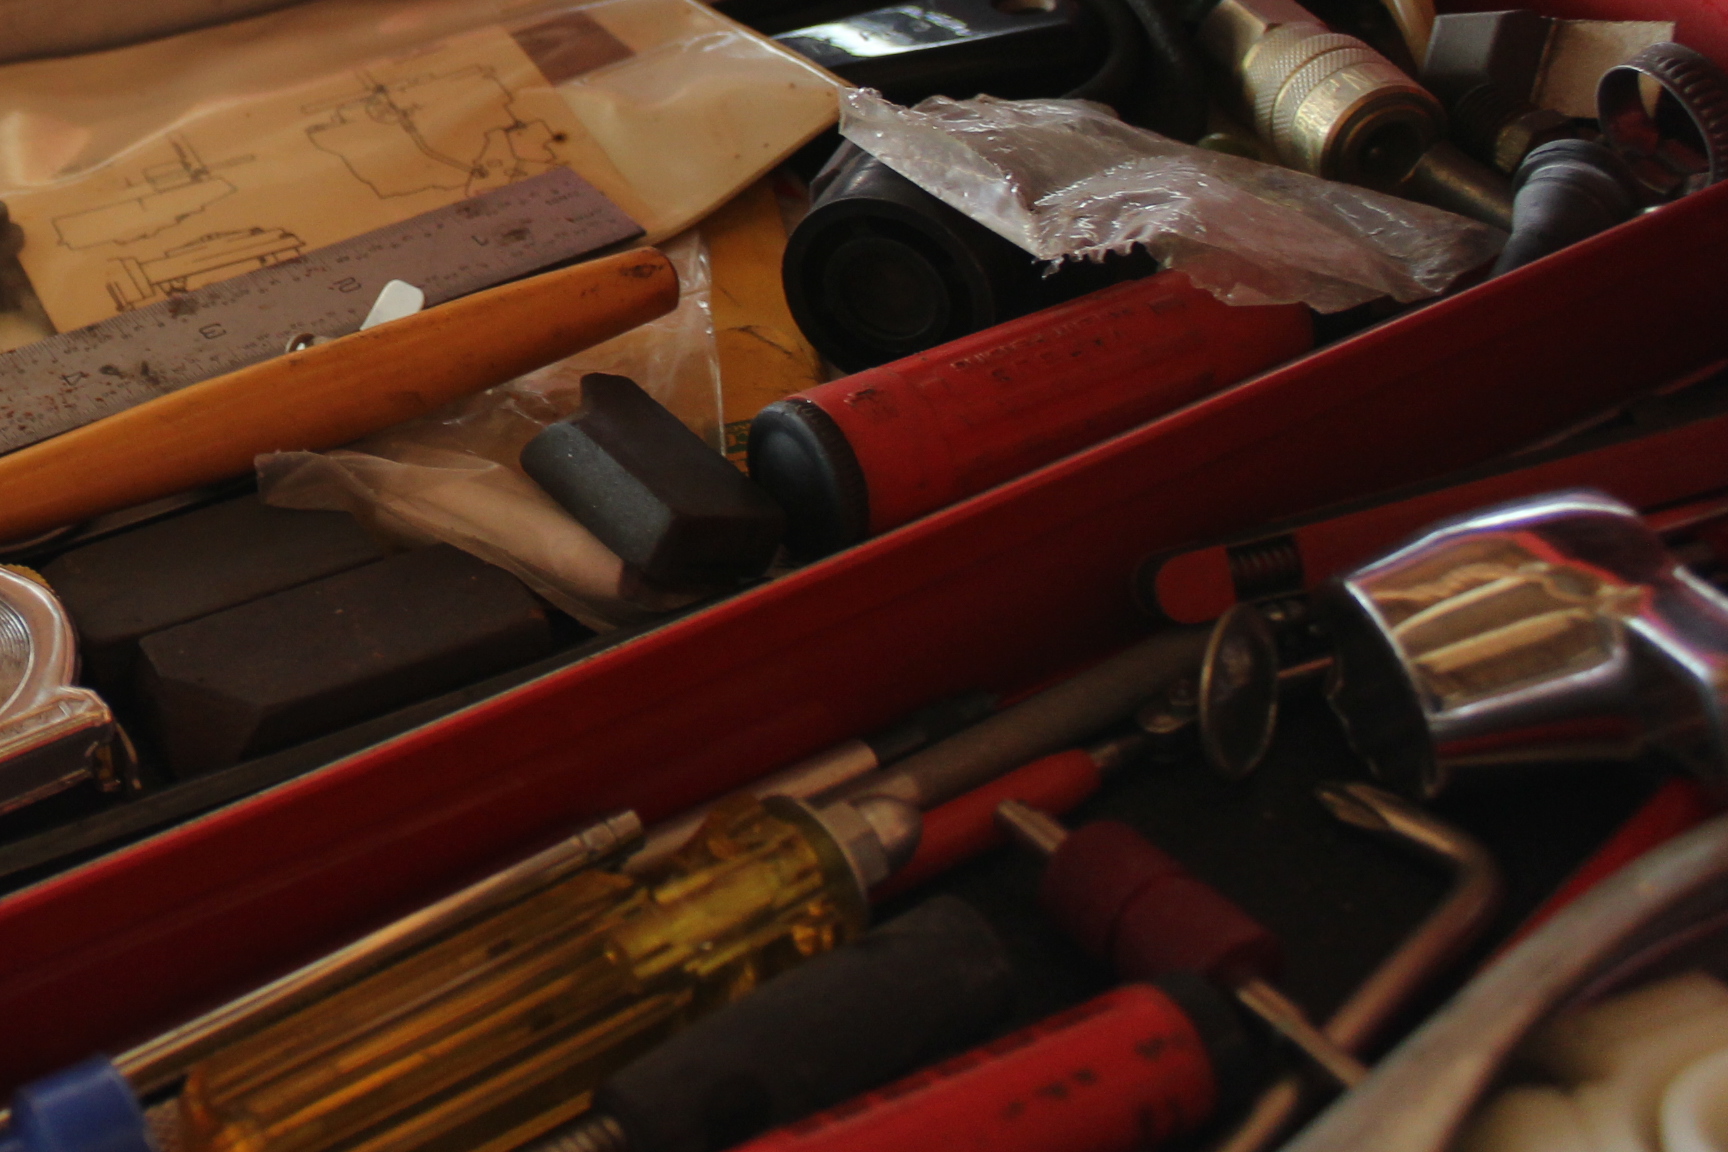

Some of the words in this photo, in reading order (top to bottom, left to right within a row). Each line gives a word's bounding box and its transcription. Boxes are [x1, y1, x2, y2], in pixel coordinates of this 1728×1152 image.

[333, 276, 362, 294] 2
[199, 322, 226, 340] 3
[60, 370, 90, 386] 4
